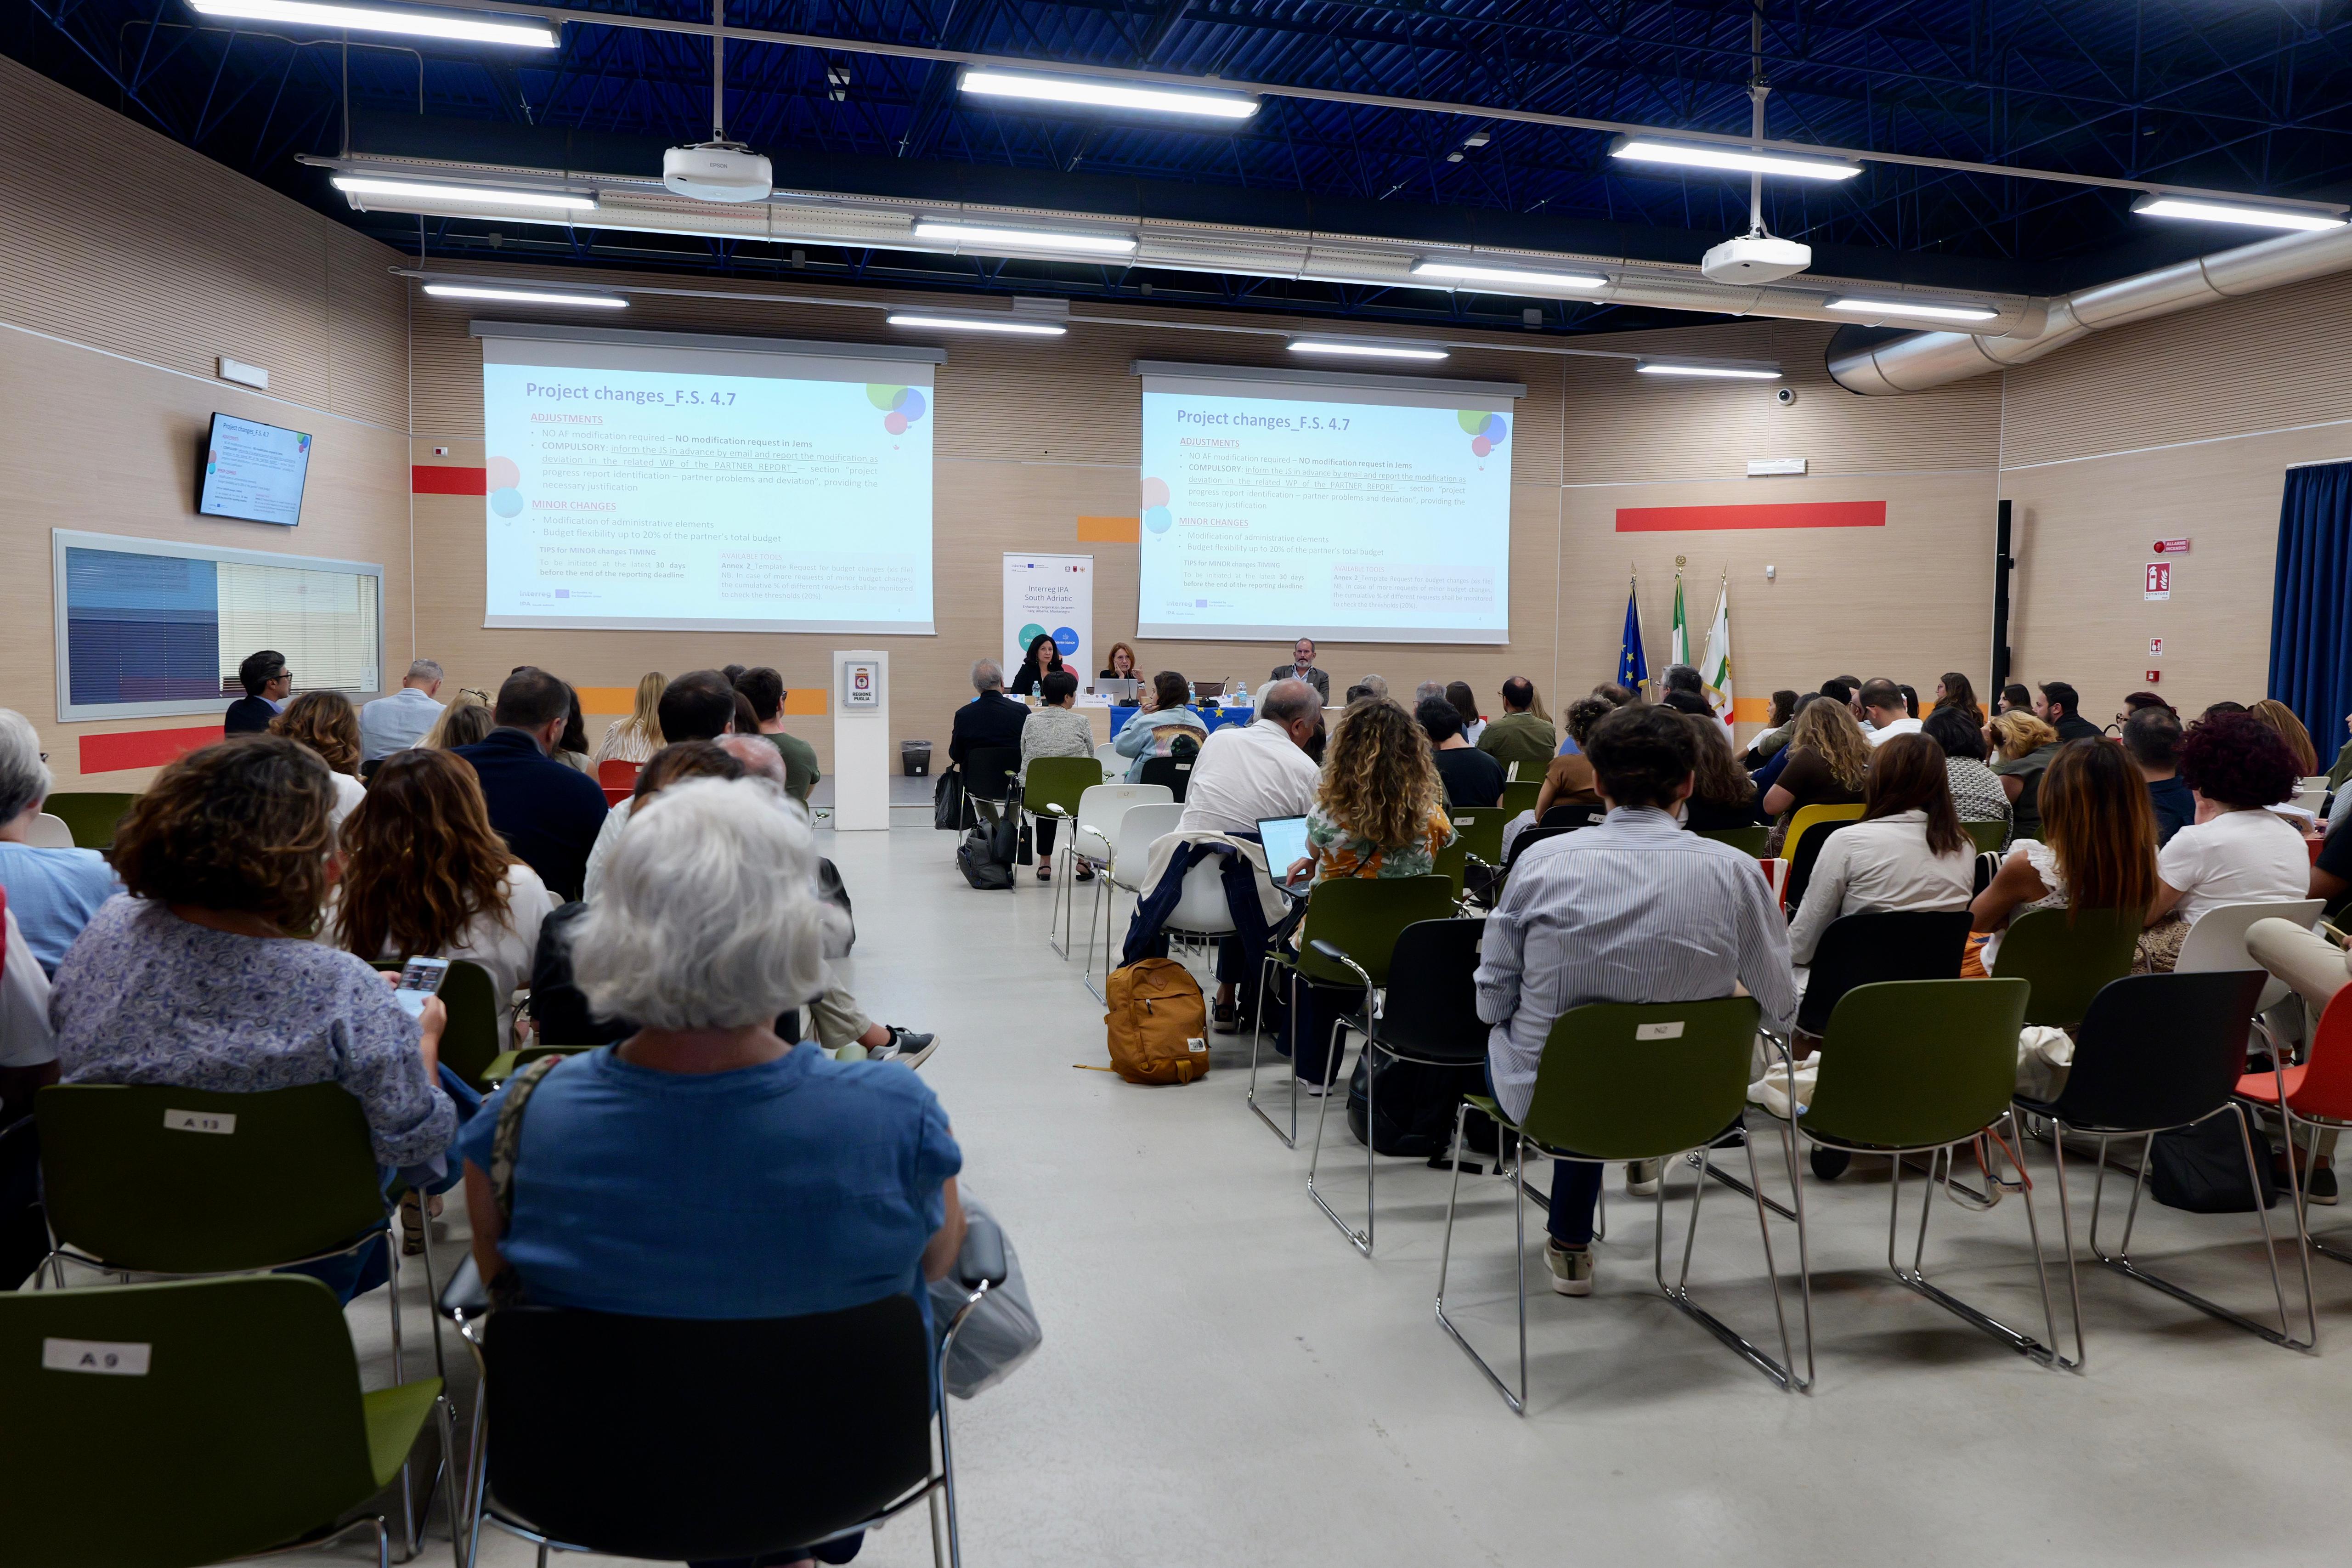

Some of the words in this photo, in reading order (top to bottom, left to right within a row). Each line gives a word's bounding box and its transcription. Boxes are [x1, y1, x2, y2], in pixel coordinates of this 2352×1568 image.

[526, 383, 588, 402] Project
[594, 385, 705, 407] changes_F.S.
[710, 391, 736, 406] 4.7
[530, 413, 603, 424] ADJUSTMENTS
[1177, 410, 1229, 427] Project
[1233, 412, 1324, 432] changes_F.S.
[1329, 418, 1351, 431] 4.7
[223, 423, 237, 431] Project
[542, 429, 556, 437] NO
[558, 430, 570, 438] AF
[572, 430, 626, 440] modification
[629, 433, 665, 443] required
[675, 435, 689, 443] NO
[691, 435, 746, 445] modification
[748, 439, 780, 448] request
[782, 439, 790, 447] in
[792, 439, 813, 448] Jems
[1180, 437, 1240, 447] ADJUSTMENTS
[542, 442, 609, 452] COMPULSORY:
[611, 444, 640, 453] inform
[642, 445, 656, 454] the
[679, 447, 715, 456] advance
[717, 448, 727, 459] by
[729, 449, 752, 458] email
[754, 450, 770, 459] and
[773, 452, 798, 461] report
[801, 451, 814, 460] the
[817, 453, 867, 462] modification
[542, 454, 583, 464] deviation
[589, 457, 597, 465] in
[603, 457, 617, 465] the
[623, 458, 654, 467] related
[660, 459, 675, 468] WP
[680, 459, 690, 468] of
[695, 460, 709, 469] the
[714, 461, 753, 470] PARTNER
[758, 463, 792, 472] REPORT
[810, 465, 840, 474] section
[1214, 453, 1259, 462] modification
[1260, 455, 1291, 464] required
[1312, 457, 1357, 466] modification
[1358, 460, 1385, 469] request
[1188, 464, 1243, 473] COMPULSORY:
[1245, 465, 1269, 474] inform
[1271, 466, 1283, 475] the
[1302, 468, 1331, 476] advance
[1333, 469, 1341, 479] by
[1379, 472, 1400, 481] report
[1402, 472, 1413, 480] the
[1415, 473, 1457, 482] modification
[543, 470, 580, 479] progress
[583, 470, 611, 480] report
[613, 470, 670, 480] identification
[681, 473, 712, 483] partner
[716, 474, 755, 484] problems
[758, 475, 774, 484] and
[824, 478, 862, 489] providing
[864, 478, 878, 487] the
[543, 482, 585, 492] necessary
[587, 481, 638, 492] justification
[532, 500, 568, 509] MINOR
[570, 501, 616, 511] CHANGES
[543, 516, 598, 526] Modification
[600, 517, 610, 526] of
[611, 518, 673, 527] administrative
[675, 519, 714, 528] elements
[1179, 518, 1208, 526] MINOR
[1210, 518, 1249, 526] CHANGES
[543, 528, 575, 539] Budget
[576, 529, 616, 540] flexibility
[618, 532, 629, 540] up
[663, 531, 673, 539] of
[674, 531, 688, 540] the
[730, 532, 750, 541] total
[752, 533, 781, 544] budget
[1187, 532, 1233, 541] Modification
[1244, 533, 1295, 542] administrative
[1296, 535, 1329, 543] elements
[597, 547, 627, 556] changes
[568, 559, 597, 567] initiated
[669, 561, 686, 570] days
[619, 571, 652, 580] reporting
[1029, 585, 1056, 594] Interreg
[184, 1117, 196, 1128] A
[203, 1119, 219, 1130] 13
[79, 1352, 97, 1368] A
[104, 1353, 119, 1369] 9
